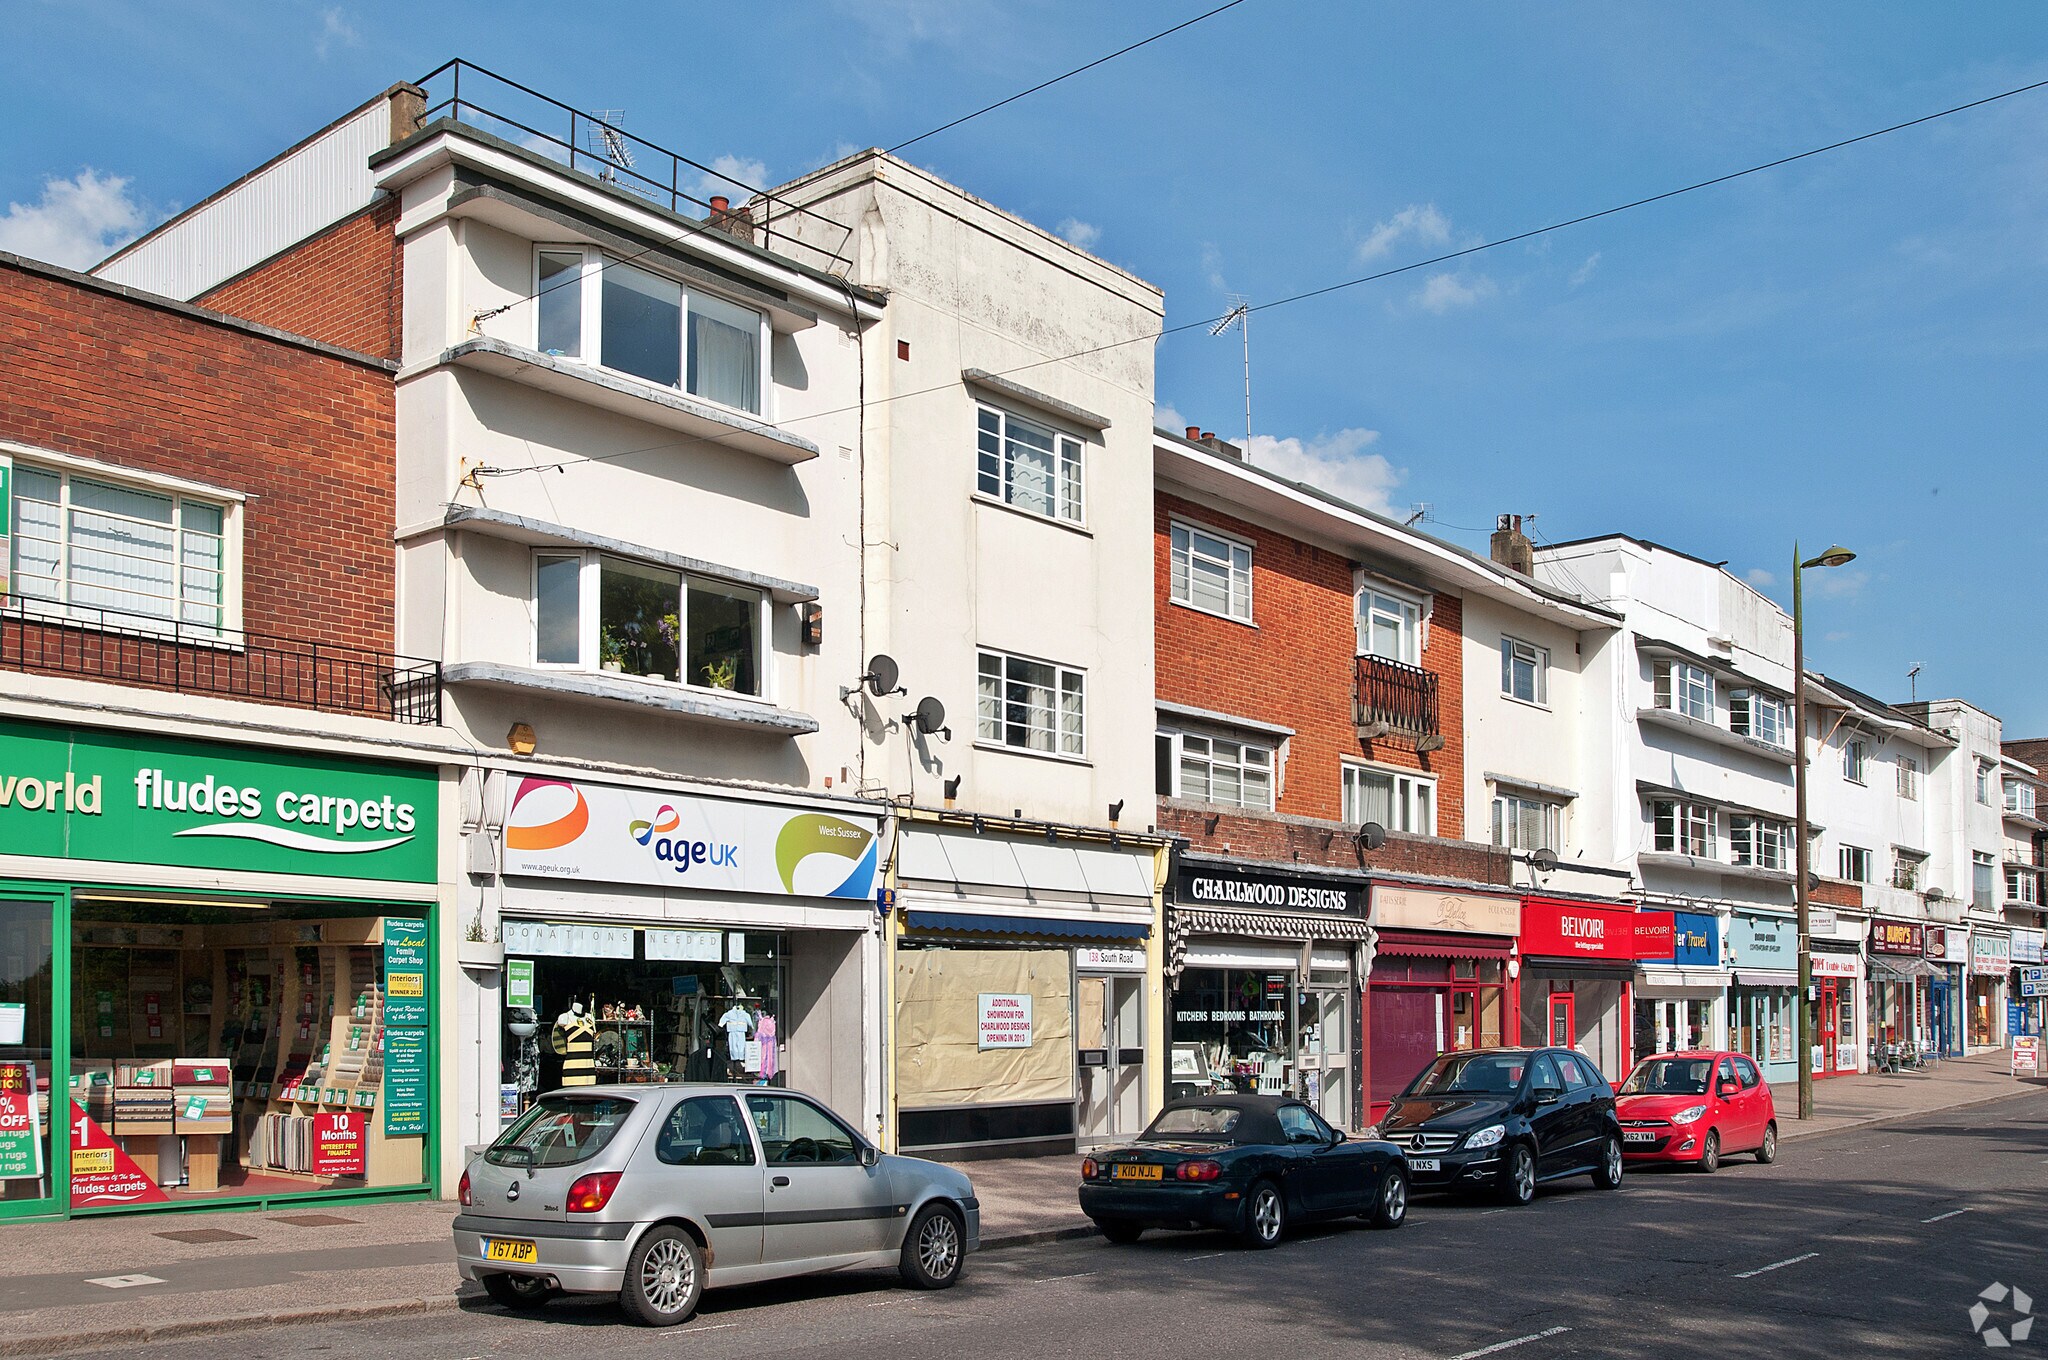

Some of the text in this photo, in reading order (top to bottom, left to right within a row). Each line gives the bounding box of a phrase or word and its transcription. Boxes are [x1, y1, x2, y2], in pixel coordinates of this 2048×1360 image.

[135, 768, 262, 817] fludes
[276, 794, 416, 834] carpets
[819, 825, 862, 839] West Sussex
[521, 862, 581, 875] www.ageuk.org.uk
[1192, 877, 1347, 911] CHARLWOOD DESIGNS
[404, 921, 425, 929] carpets
[1561, 915, 1604, 939] BELVOIR!
[1634, 926, 1670, 935] BELVOIR!
[508, 926, 629, 943] DONATIONS
[650, 934, 717, 946] NEEDED
[1687, 930, 1707, 948] Travel
[386, 936, 426, 947] Your Local
[395, 947, 416, 956] Family
[388, 956, 423, 965] Carpet Shop
[1088, 952, 1134, 963] 138 South Road
[389, 974, 419, 982] Interiors
[992, 999, 1019, 1007] ADDITIONAL
[386, 1004, 425, 1013] Carpet Retailer
[392, 1013, 398, 1021] of
[407, 1013, 419, 1021] Year
[987, 1010, 1025, 1019] SHOWROOM FOR
[1176, 1010, 1285, 1022] KITCHENS BEDROOMS BATHROOMS
[981, 1022, 1030, 1030] CHARLWOOD DESIGNS
[986, 1034, 1025, 1042] OPENING IN 2013
[1, 1114, 27, 1127] OFF
[331, 1114, 349, 1130] 10
[74, 1116, 89, 1147] 1
[408, 1123, 425, 1131] Help!
[321, 1130, 357, 1141] Months
[1640, 1132, 1655, 1141] VWA
[5, 1152, 28, 1161] rugs
[74, 1151, 108, 1160] Interiors
[4, 1163, 27, 1171] rugs
[1416, 1160, 1433, 1170] NXS
[1137, 1165, 1156, 1178] NJL
[72, 1180, 148, 1194] fludes carpets
[492, 1241, 533, 1259] Y67 ABP
